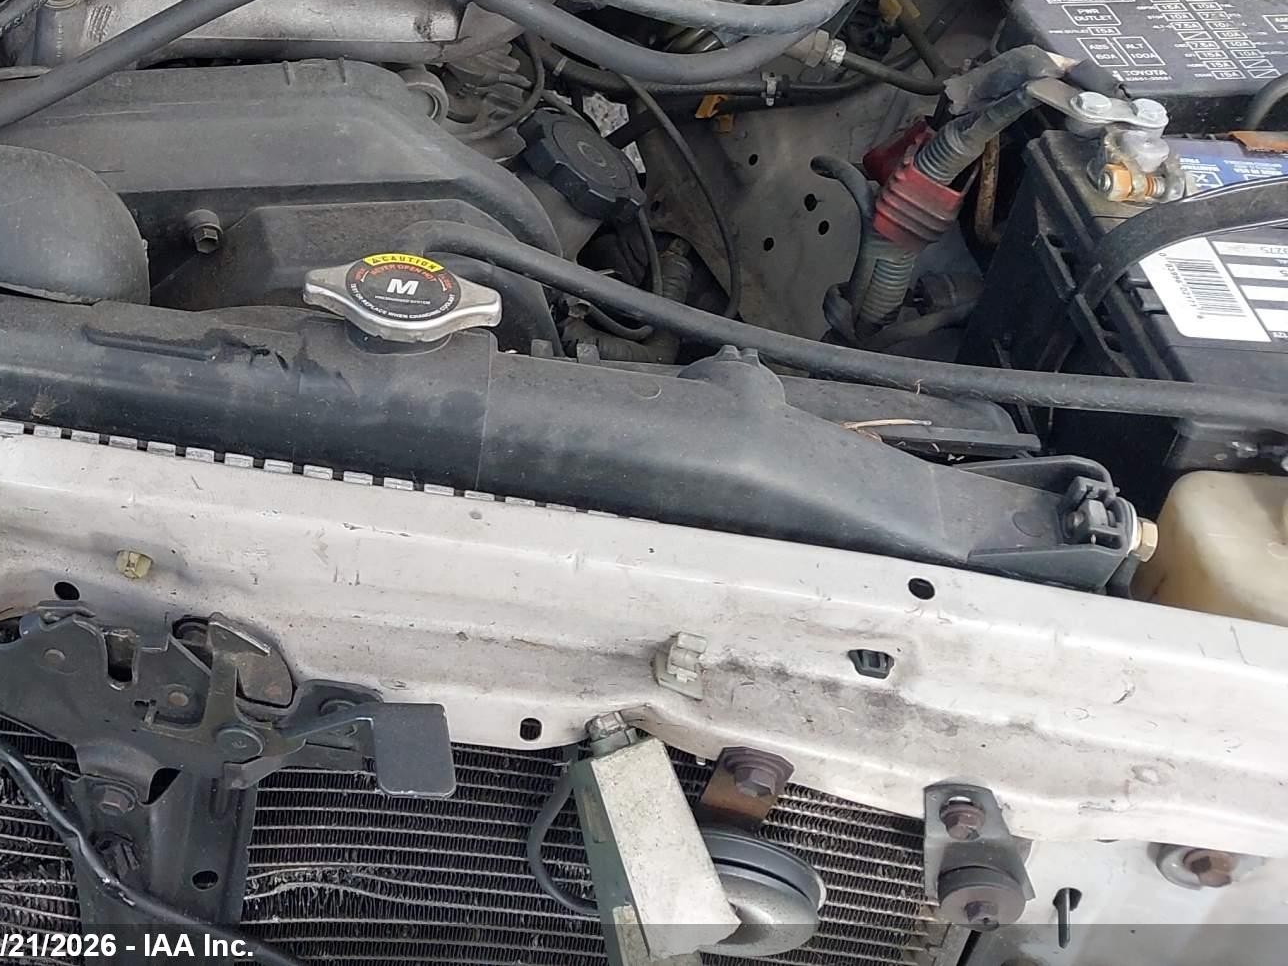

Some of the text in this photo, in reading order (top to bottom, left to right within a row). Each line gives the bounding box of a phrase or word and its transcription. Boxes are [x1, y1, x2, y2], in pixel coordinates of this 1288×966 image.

[381, 256, 438, 270] CAUTION
[370, 264, 396, 275] NEVER
[397, 264, 420, 273] OPEN
[422, 269, 438, 282] HOT
[386, 278, 419, 296] M
[362, 299, 388, 315] REPLACE
[388, 311, 409, 319] WHEN
